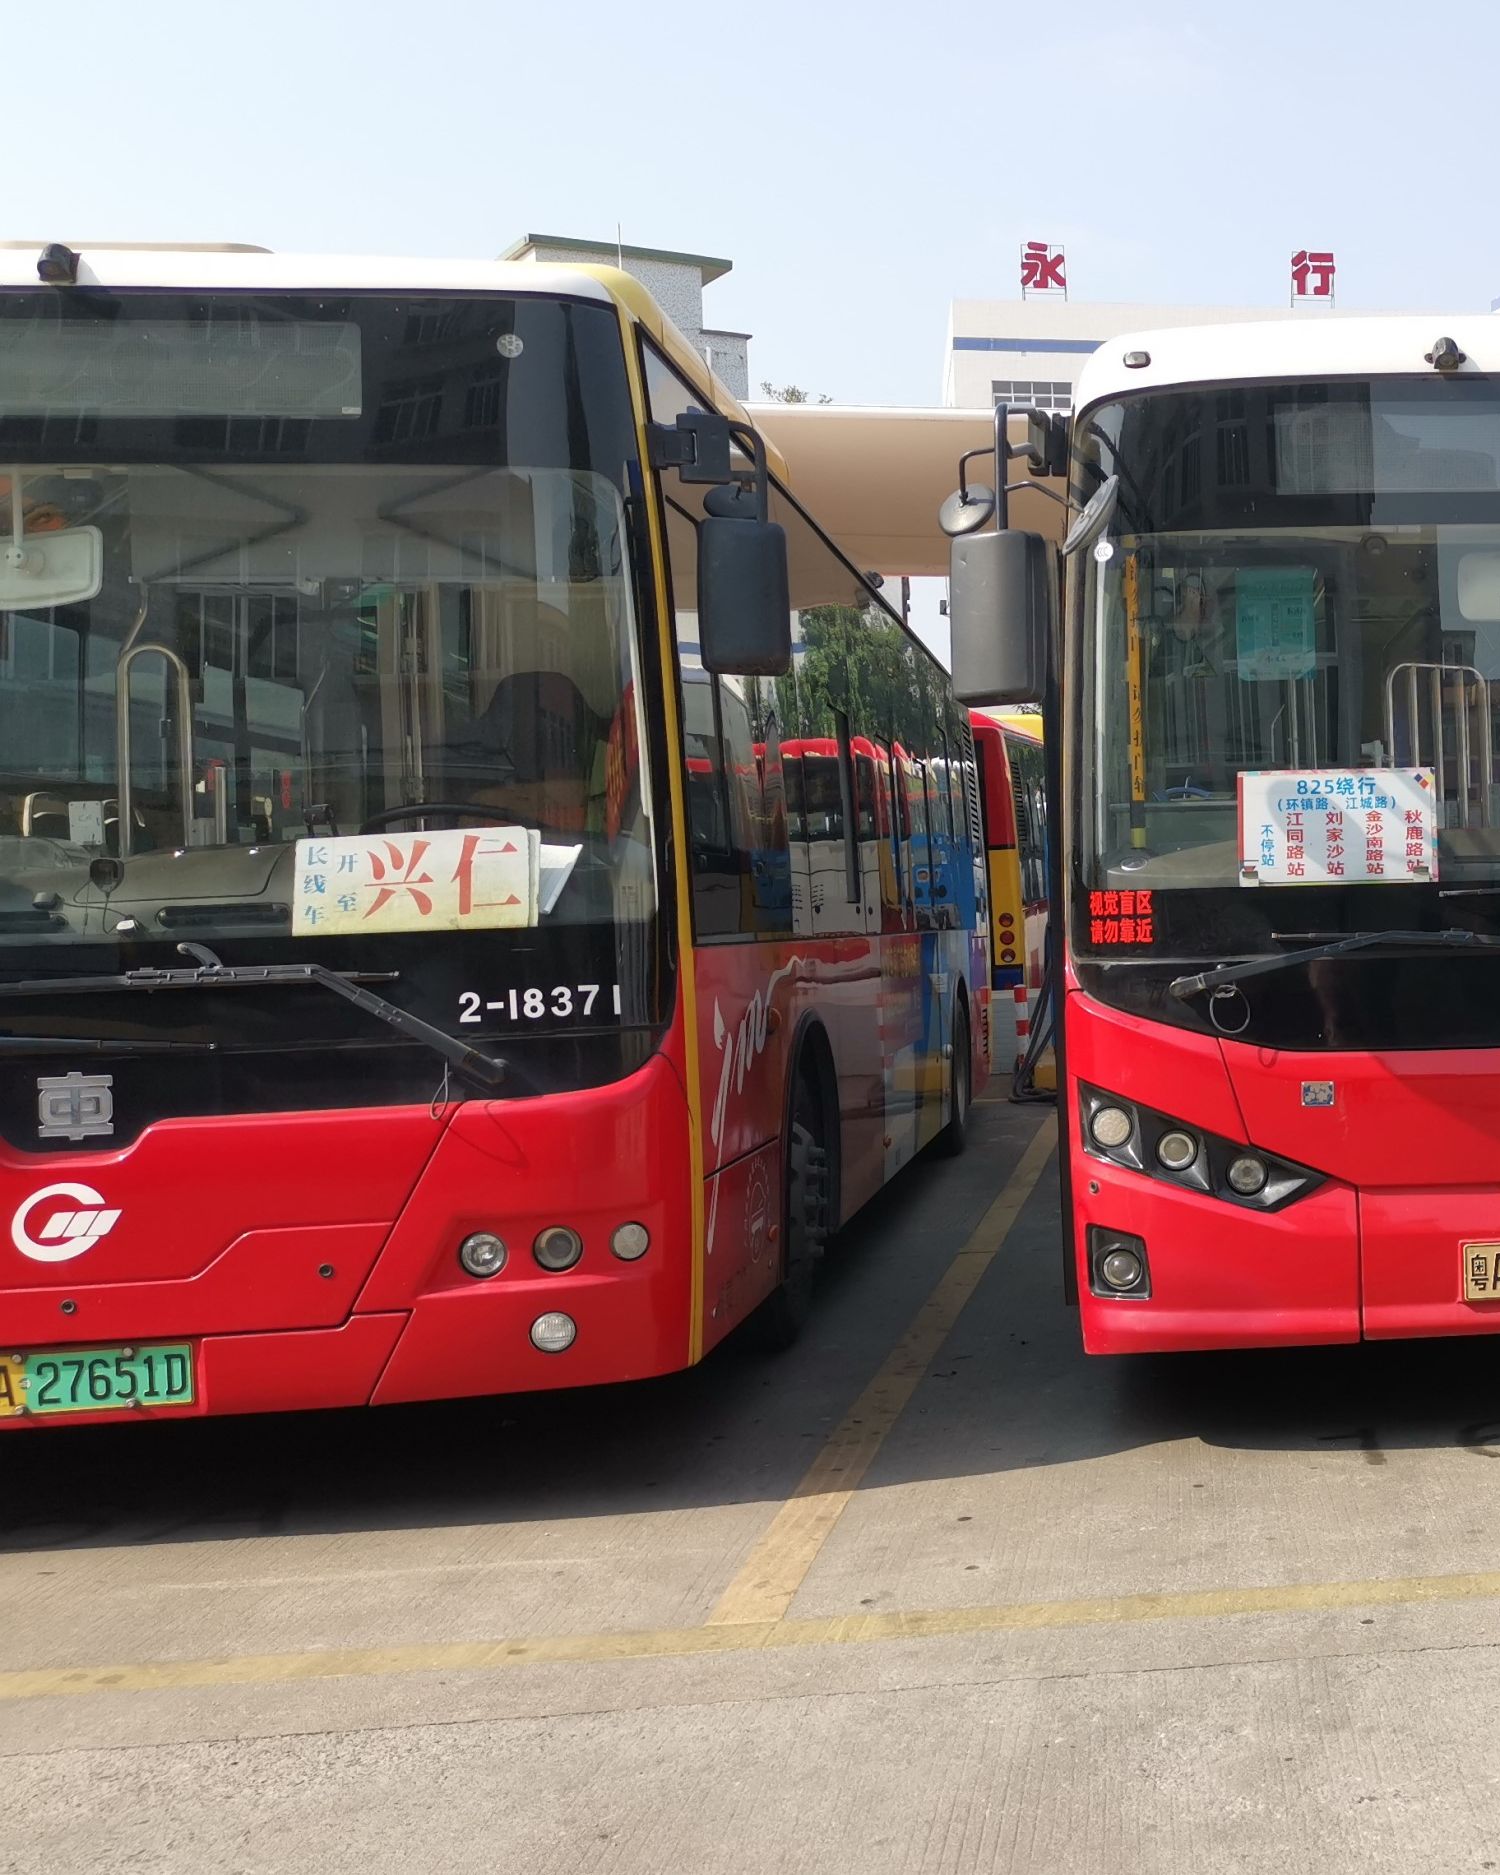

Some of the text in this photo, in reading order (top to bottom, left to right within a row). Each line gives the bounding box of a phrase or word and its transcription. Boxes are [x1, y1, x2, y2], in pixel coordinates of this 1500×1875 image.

[1297, 777, 1377, 795] 825绕行
[1260, 824, 1276, 867] 不停站
[1286, 812, 1305, 876] 江同路站
[1325, 811, 1345, 875] 刘家沙站
[1365, 810, 1385, 875] 金沙南路站
[1404, 809, 1425, 873] 秋鹿路站
[303, 845, 328, 925] 长线车
[336, 853, 359, 912] 开至
[362, 834, 522, 920] 兴仁
[1090, 890, 1153, 915] 视觉盲区
[1090, 918, 1153, 944] 请勿靠近
[458, 984, 621, 1023] 2-18371
[36, 1353, 188, 1407] 27651D
